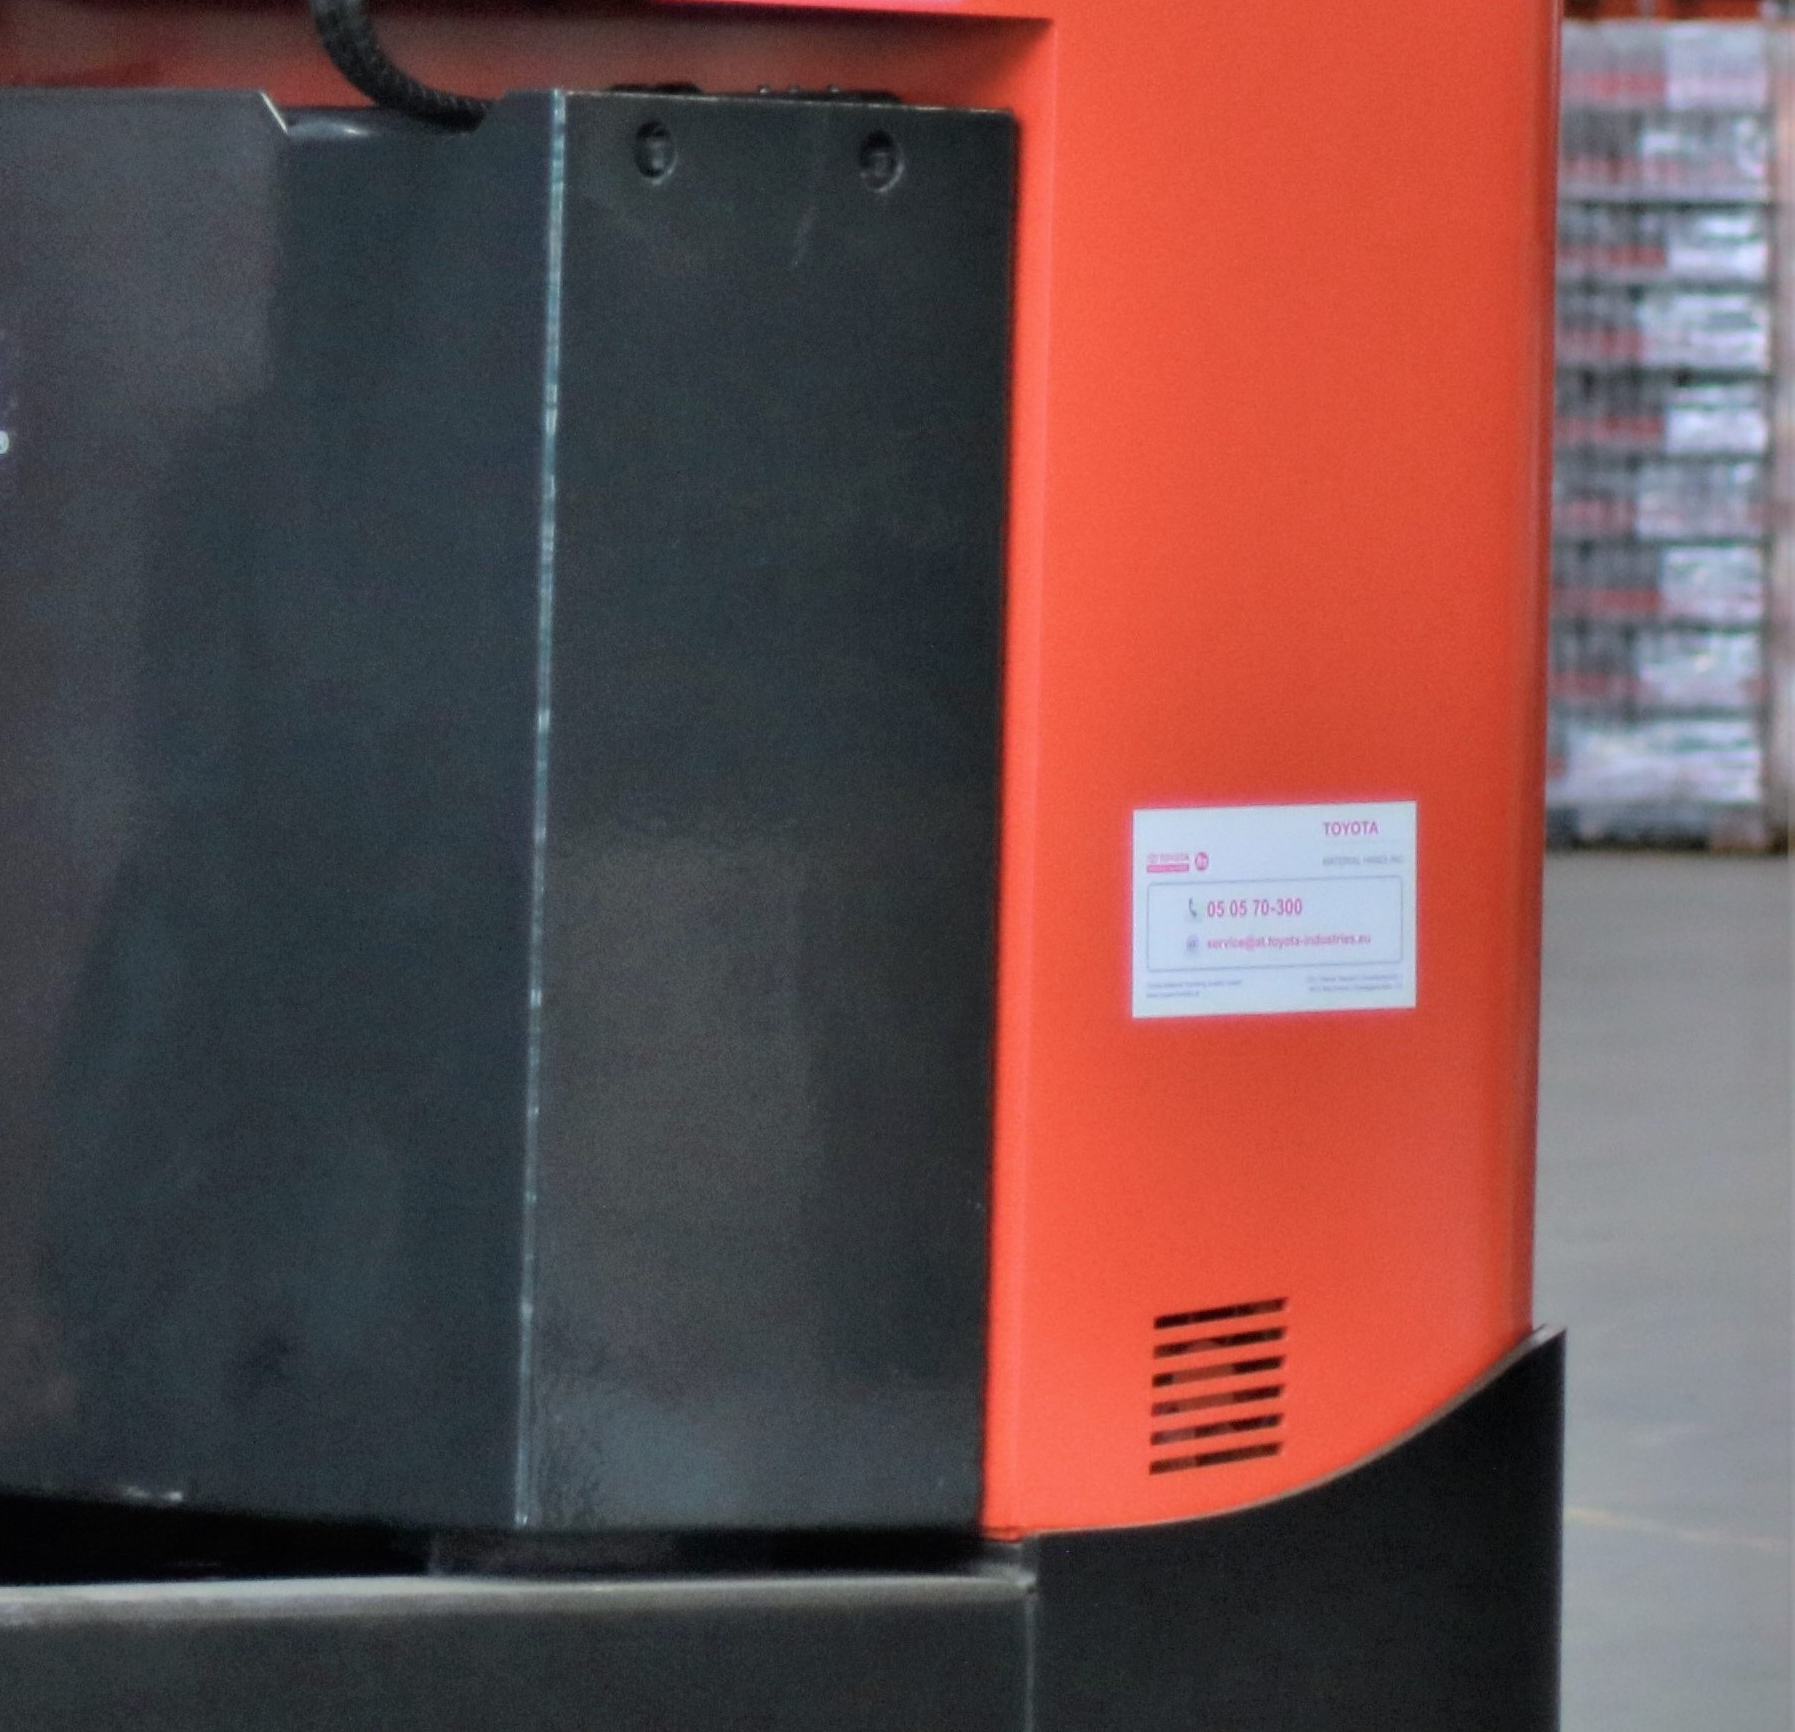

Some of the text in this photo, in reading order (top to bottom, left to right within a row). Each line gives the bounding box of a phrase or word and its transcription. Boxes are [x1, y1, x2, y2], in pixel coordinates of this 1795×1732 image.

[1323, 820, 1379, 836] TOYOTA
[1207, 898, 1303, 917] 05 05 70-300
